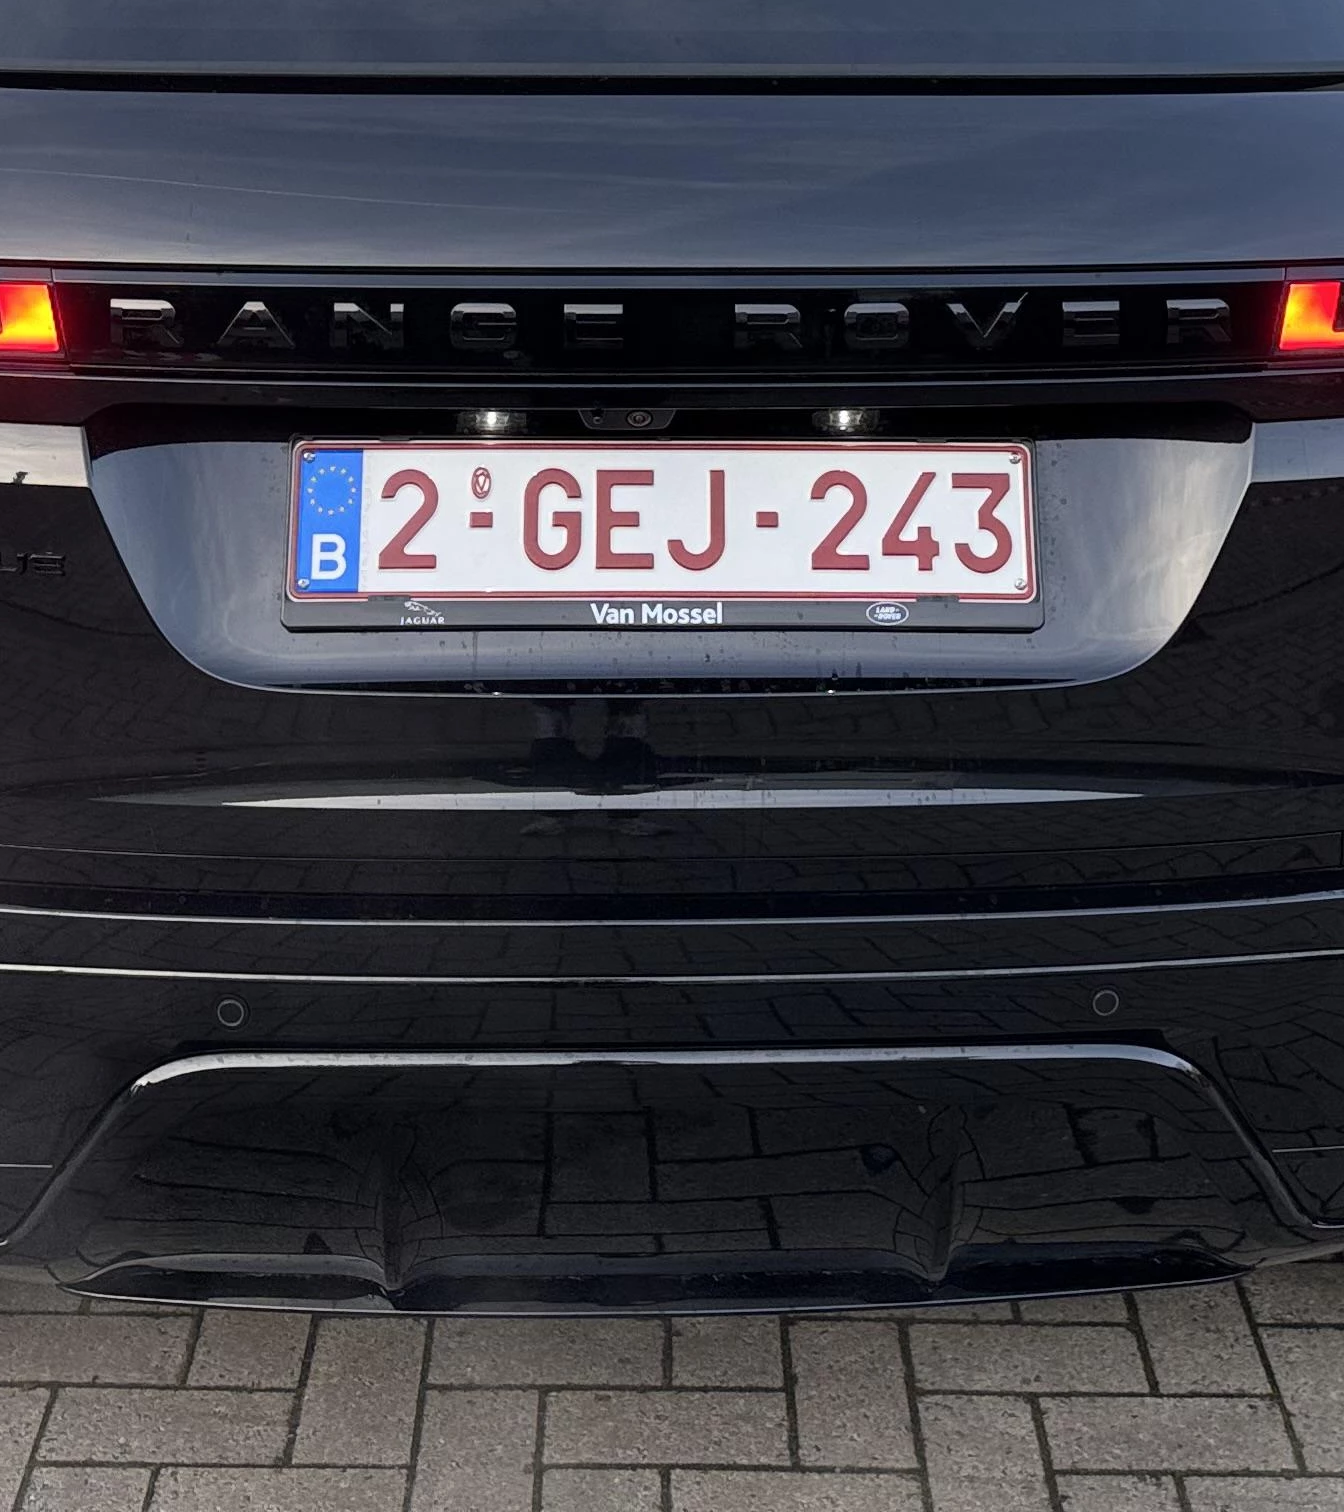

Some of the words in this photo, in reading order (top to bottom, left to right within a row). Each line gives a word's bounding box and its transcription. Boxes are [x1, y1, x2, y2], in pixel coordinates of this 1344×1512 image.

[109, 298, 624, 350] RANGE
[734, 296, 1232, 350] ROVER
[378, 467, 1013, 574] 2-GEJ-243
[311, 533, 348, 581] B
[400, 615, 446, 626] JAGUAR
[589, 602, 635, 625] Van
[641, 601, 723, 625] Mossel
